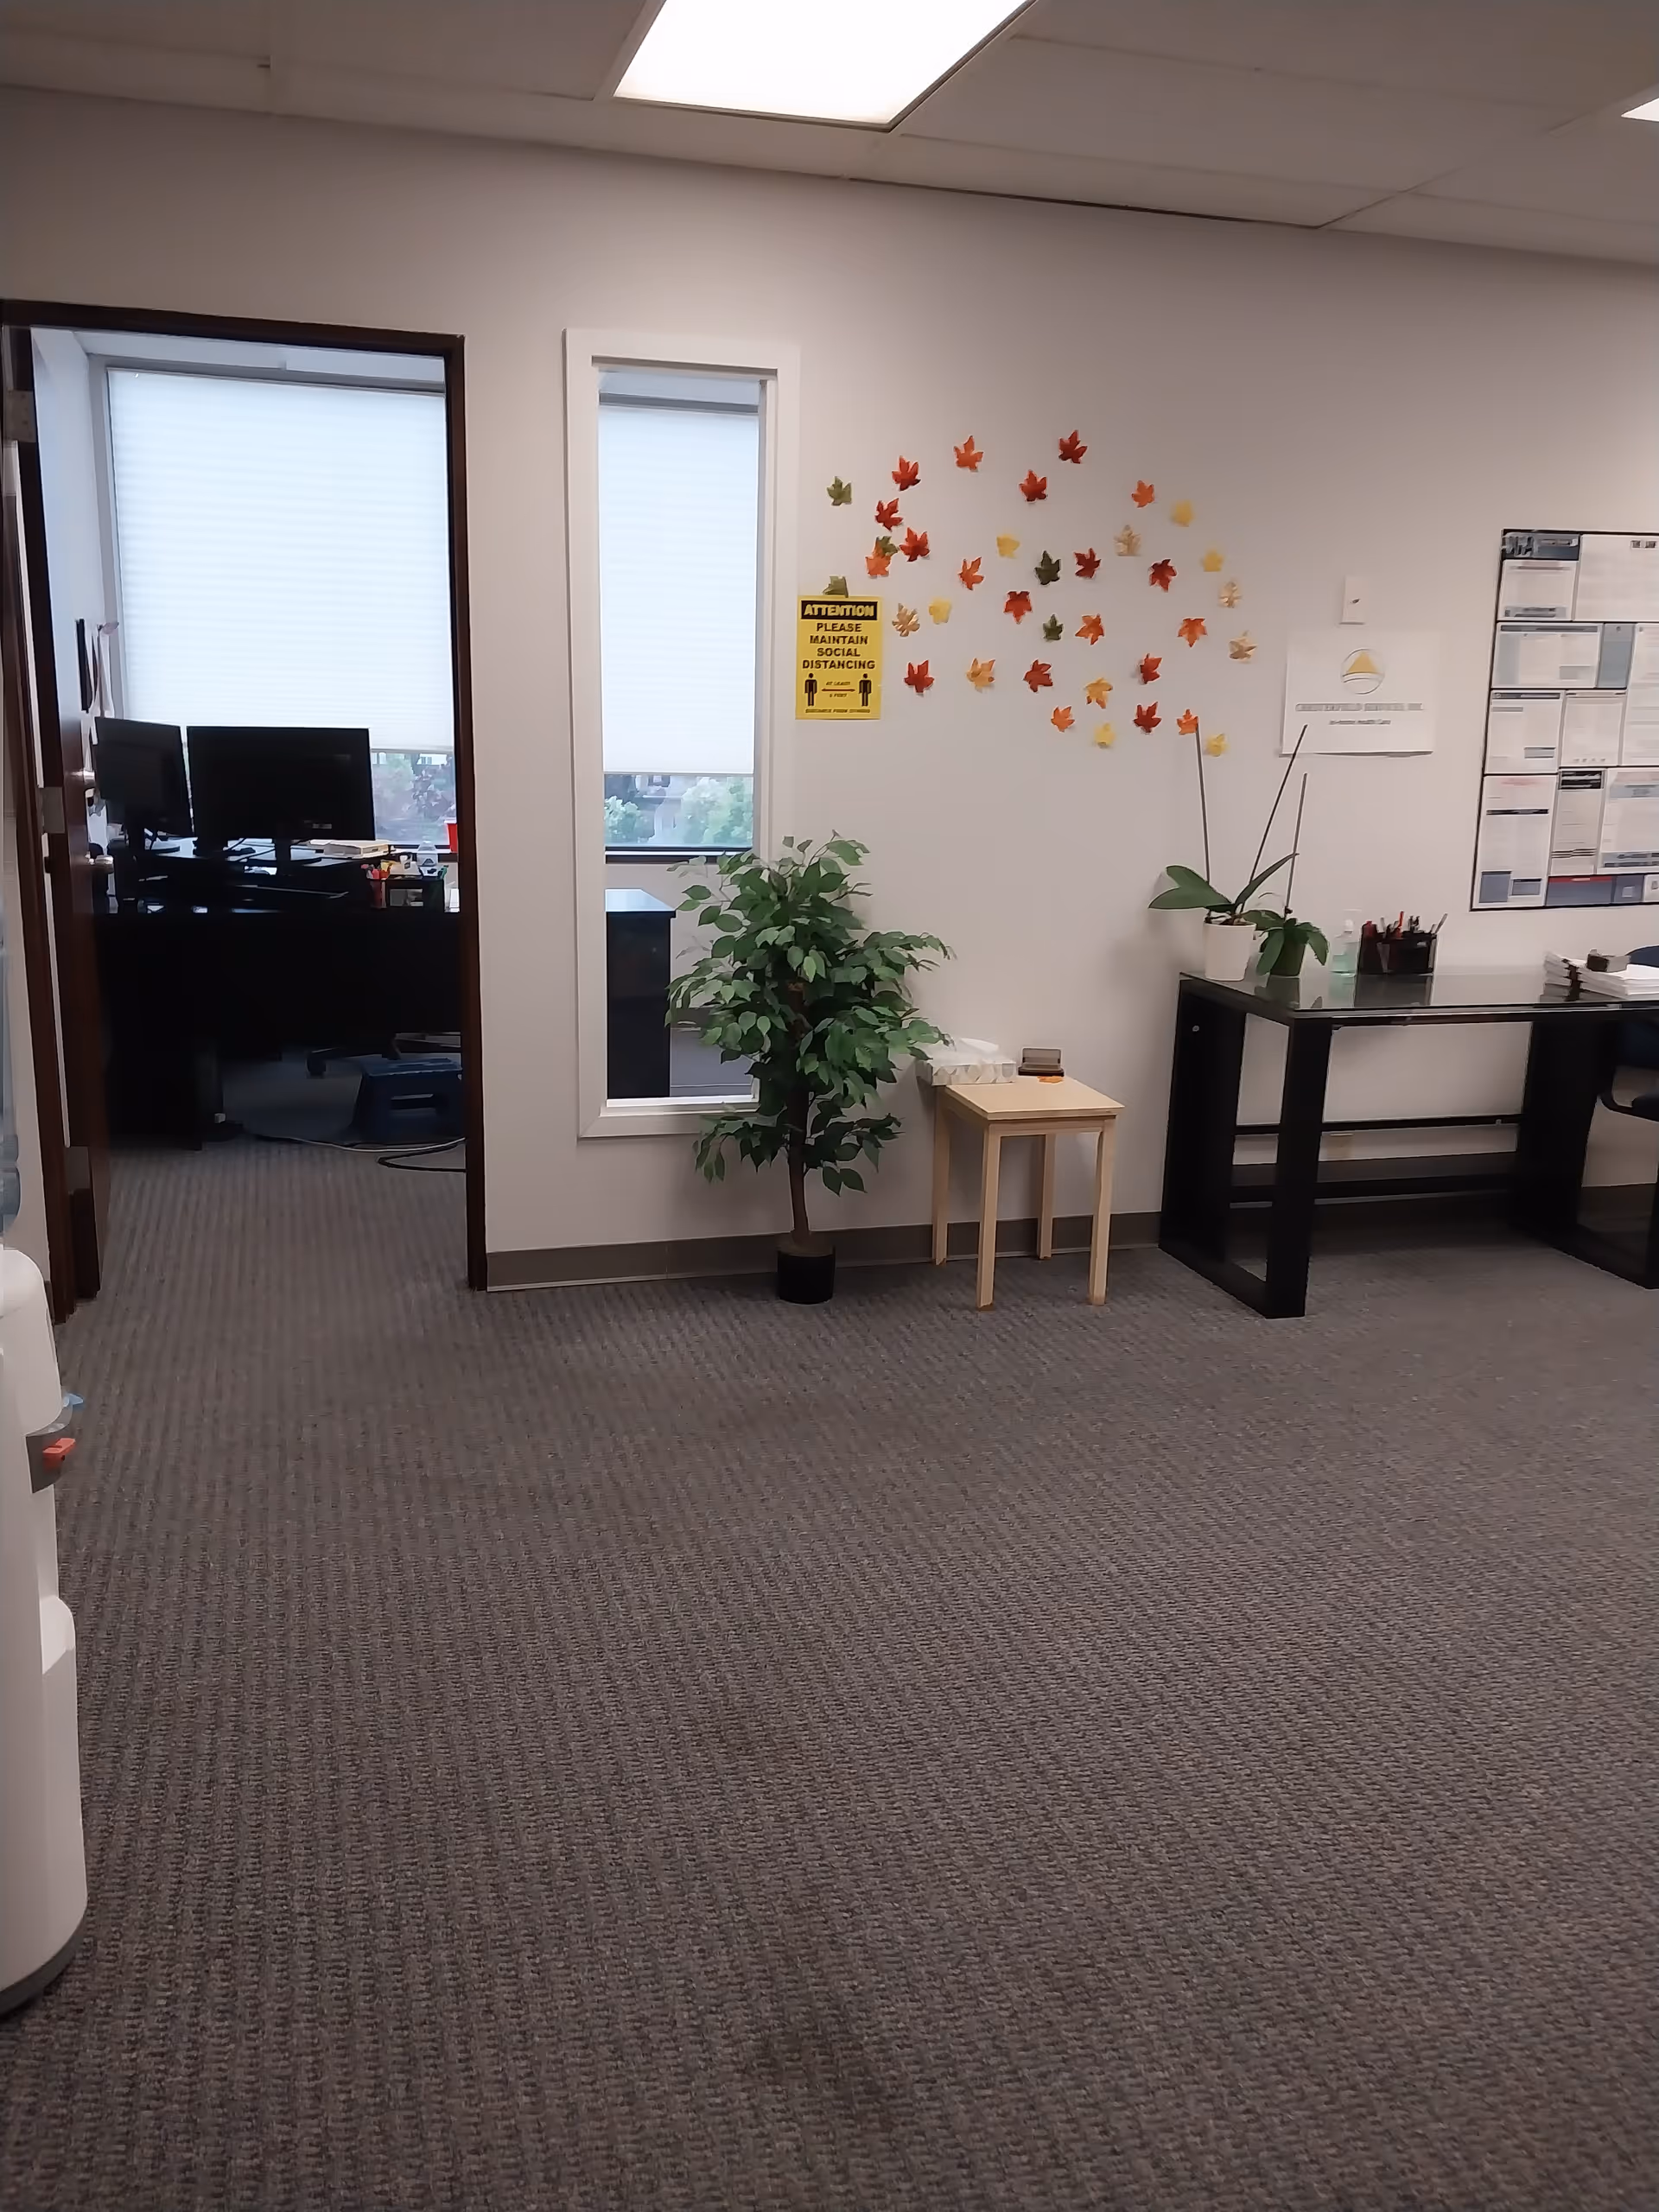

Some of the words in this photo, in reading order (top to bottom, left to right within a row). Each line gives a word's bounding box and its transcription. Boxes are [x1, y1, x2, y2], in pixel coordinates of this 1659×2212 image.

[804, 604, 874, 617] ATTENTION
[817, 622, 862, 632] PLEASE
[810, 635, 868, 645] MAINTAIN
[817, 647, 861, 657] SOCIAL
[802, 659, 875, 670] DISTANCING
